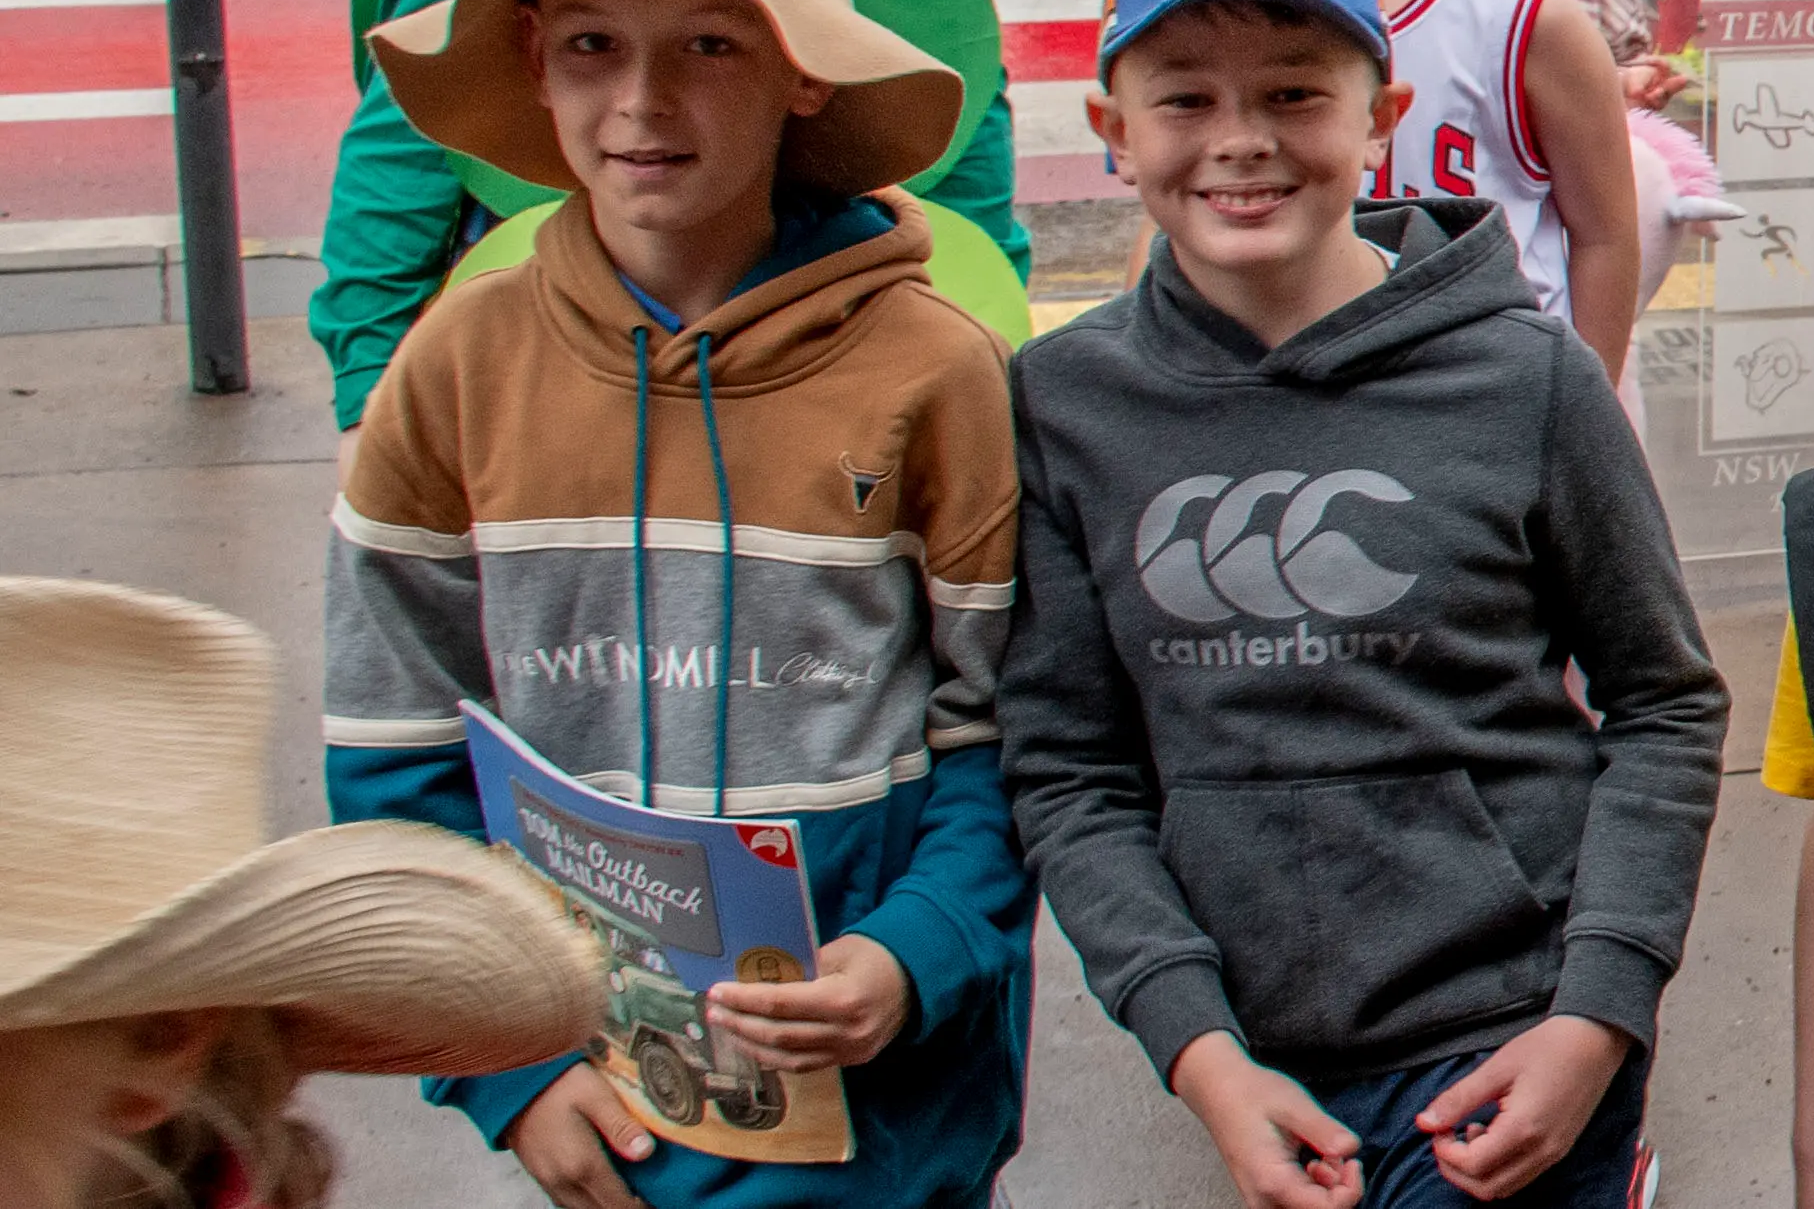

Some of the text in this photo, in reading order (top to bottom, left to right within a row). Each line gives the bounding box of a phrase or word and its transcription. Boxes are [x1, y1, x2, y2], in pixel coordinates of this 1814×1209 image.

[1713, 453, 1800, 487] NSW
[1149, 621, 1421, 667] canterbury
[586, 841, 703, 916] Outback
